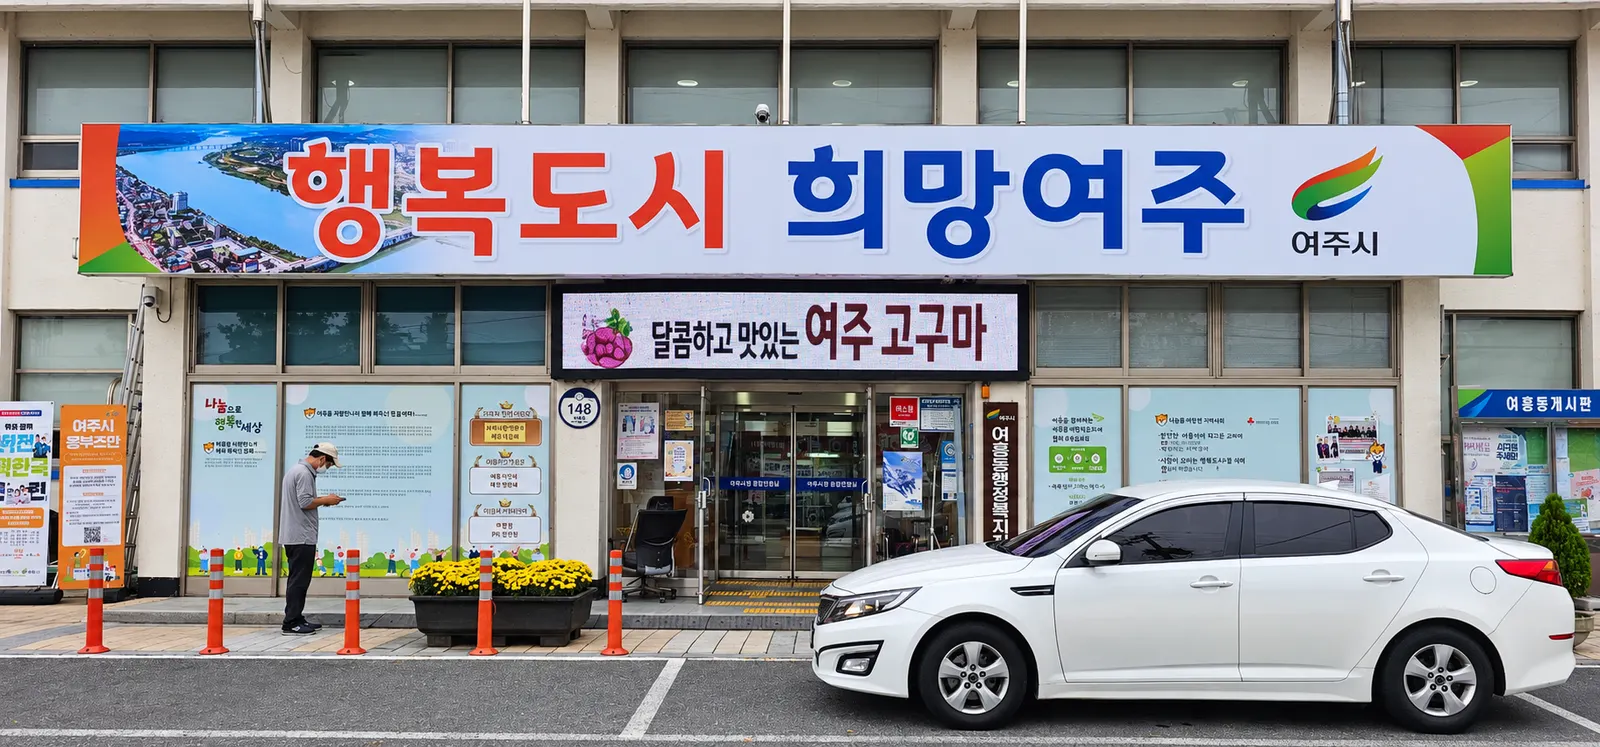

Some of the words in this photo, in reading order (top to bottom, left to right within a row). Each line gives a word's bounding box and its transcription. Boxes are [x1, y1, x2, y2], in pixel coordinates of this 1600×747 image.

[287, 140, 724, 259] 행복도시
[787, 143, 1246, 260] 희망여주
[1290, 230, 1379, 257] 여주시
[651, 319, 734, 360] 달콤하고
[737, 320, 800, 360] 맛있는
[804, 301, 874, 361] 여주
[880, 302, 988, 363] 고구마
[204, 397, 242, 414] 나눔으로
[567, 402, 592, 415] 148
[1505, 395, 1592, 412] 여흥동게시판
[72, 418, 115, 433] 여주시
[240, 421, 263, 434] 세상
